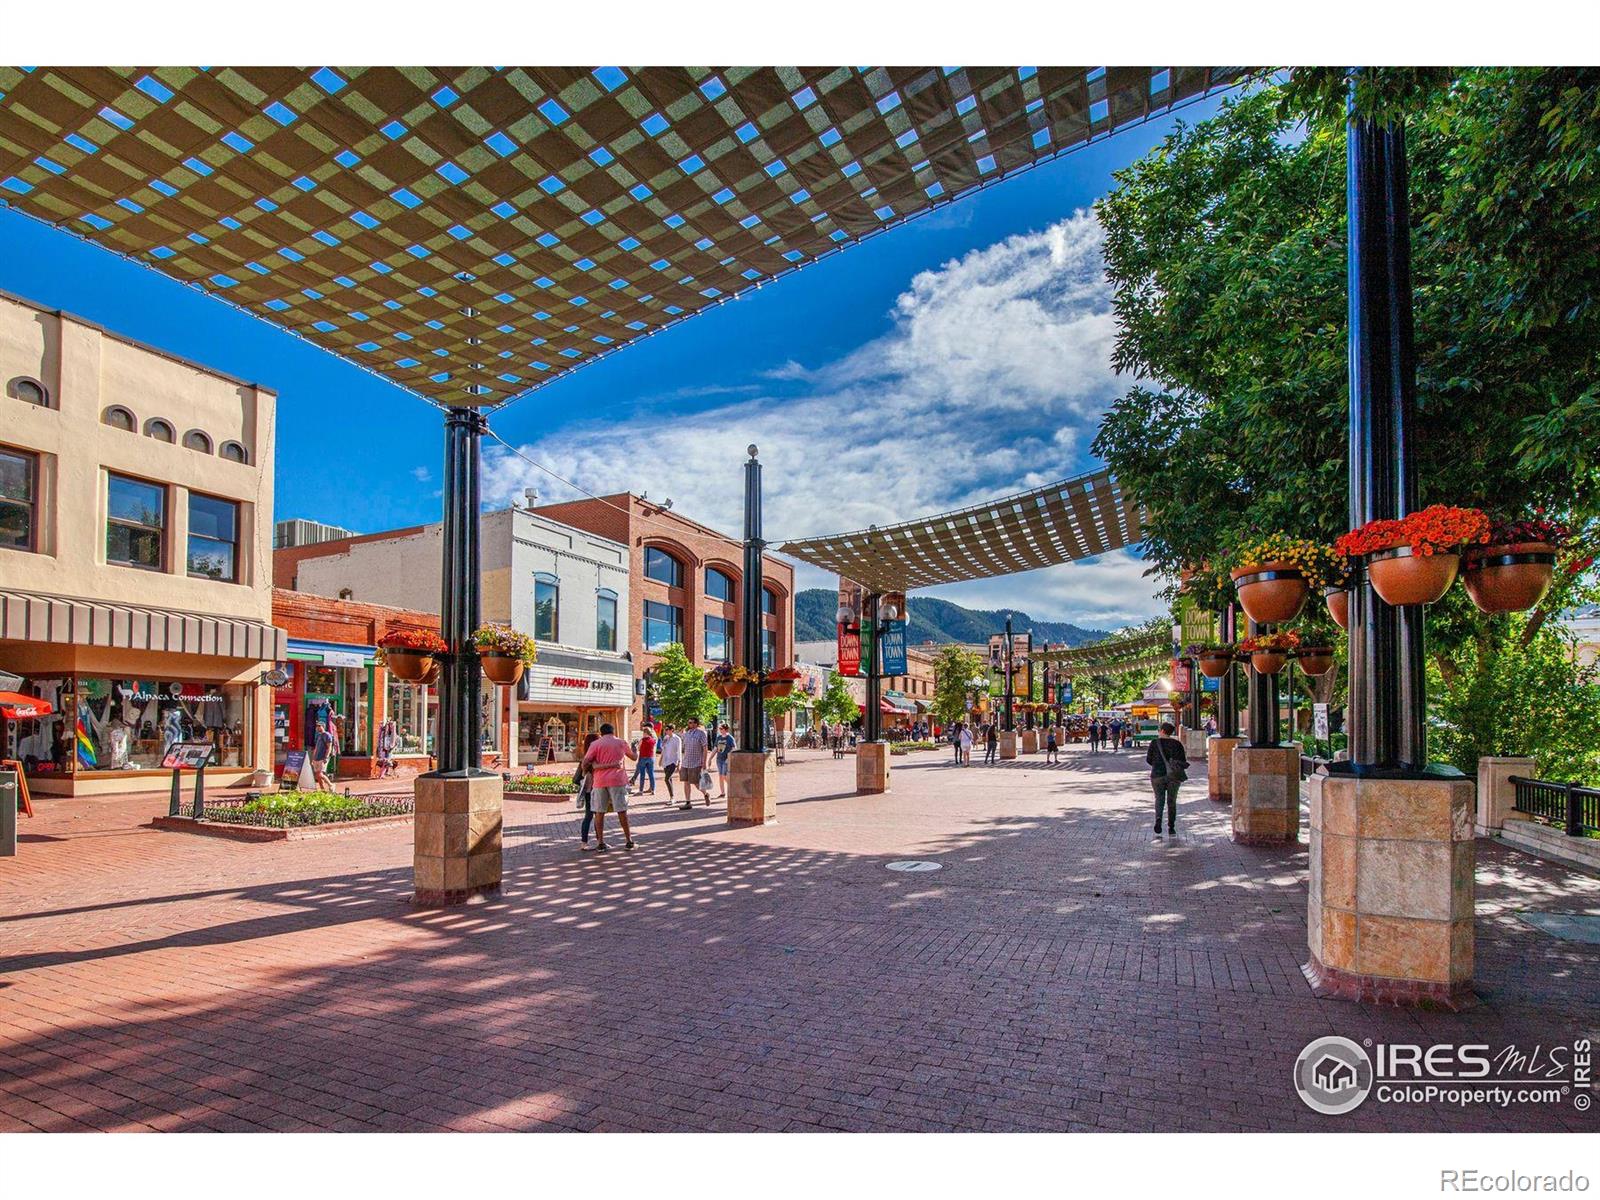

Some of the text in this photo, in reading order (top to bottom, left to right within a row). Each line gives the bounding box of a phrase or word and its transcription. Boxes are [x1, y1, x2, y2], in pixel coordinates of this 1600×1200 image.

[1185, 609, 1210, 625] DOWN
[1186, 625, 1210, 640] TOWN
[840, 634, 859, 647] DOWN
[884, 633, 903, 646] DOWN
[841, 647, 860, 660] TOWN
[884, 645, 903, 659] TOWN
[591, 680, 615, 691] GIFTS
[133, 691, 223, 702] Alpaca Connection
